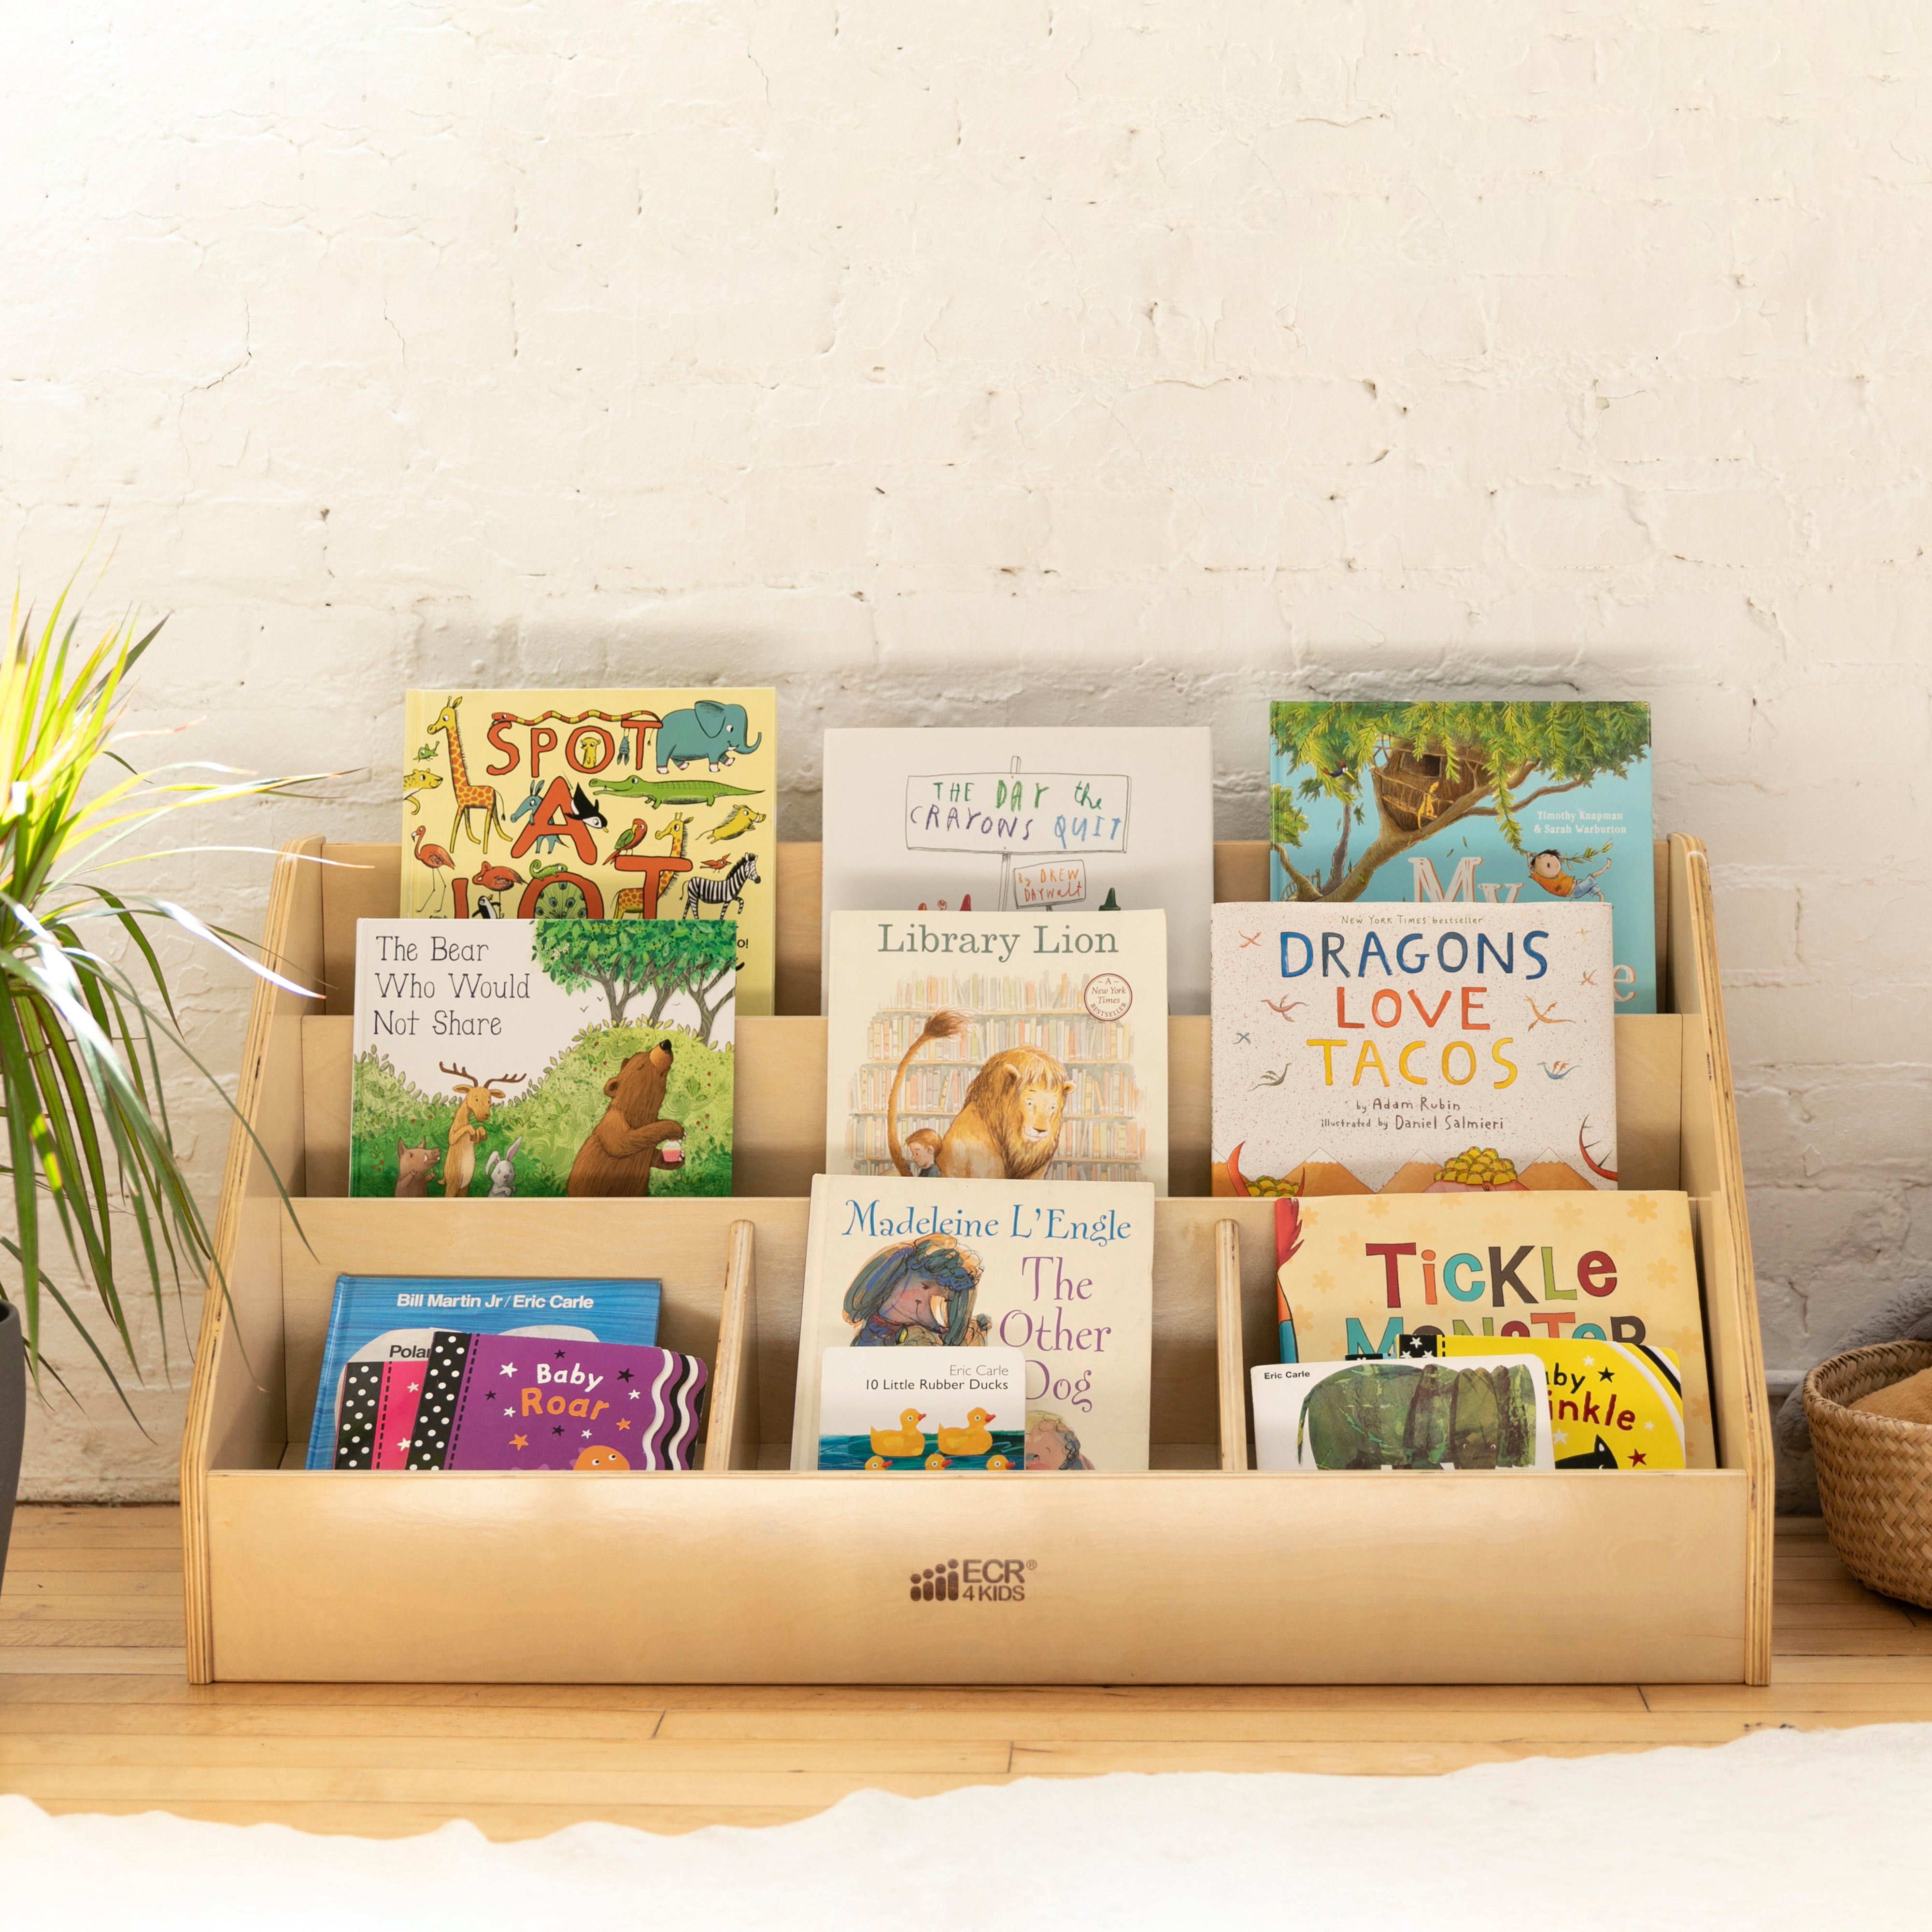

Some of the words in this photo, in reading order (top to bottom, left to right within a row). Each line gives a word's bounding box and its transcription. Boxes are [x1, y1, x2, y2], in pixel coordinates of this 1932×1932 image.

[486, 720, 663, 777] SPOT
[933, 782, 974, 802] THE
[995, 780, 1050, 812] DAY
[1074, 781, 1102, 810] the
[511, 776, 597, 865] A
[910, 804, 1033, 840] CRAYONS
[1054, 814, 1121, 849] QUIT
[1534, 824, 1542, 834] &
[1545, 824, 1571, 833] Sarah
[1575, 824, 1626, 833] Warburton
[1537, 810, 1576, 822] Timothy
[1579, 811, 1623, 822] Knapman
[1018, 872, 1031, 887] By
[1040, 868, 1079, 883] DREW
[376, 936, 418, 961] The
[430, 936, 489, 961] Bear
[878, 923, 1020, 963] Library
[1033, 925, 1119, 953] Lion
[1280, 930, 1550, 980] DRAGONS
[374, 973, 435, 998] Who
[448, 973, 530, 999] Would
[373, 1010, 420, 1036] Not
[432, 1010, 501, 1036] Share
[1090, 1002, 1127, 1017] BESTSELLER
[1336, 987, 1491, 1031] LOVE
[1306, 1037, 1518, 1090] TACOS
[1356, 1100, 1367, 1113] by
[1373, 1098, 1413, 1110] Adam
[1421, 1097, 1461, 1111] Rubin
[1321, 1118, 1371, 1127] illustrated
[1378, 1117, 1388, 1130] by
[1395, 1115, 1437, 1130] Daniel
[1445, 1115, 1504, 1130] Salmieri
[841, 1199, 999, 1237] Madeleine
[1009, 1204, 1132, 1247] L'Engle
[1022, 1256, 1093, 1302] The
[397, 1293, 423, 1307] Bill
[427, 1294, 481, 1308] Martin
[513, 1294, 547, 1308] Eric
[550, 1295, 594, 1308] Carle
[999, 1306, 1111, 1352] Other
[537, 1363, 604, 1392] Baby
[866, 1379, 878, 1390] 10
[883, 1379, 914, 1390] Little
[920, 1379, 964, 1390] Rubber
[969, 1379, 1008, 1390] Ducks
[950, 1365, 971, 1376] Eric
[976, 1365, 1009, 1376] Carle
[521, 1387, 609, 1420] Roar
